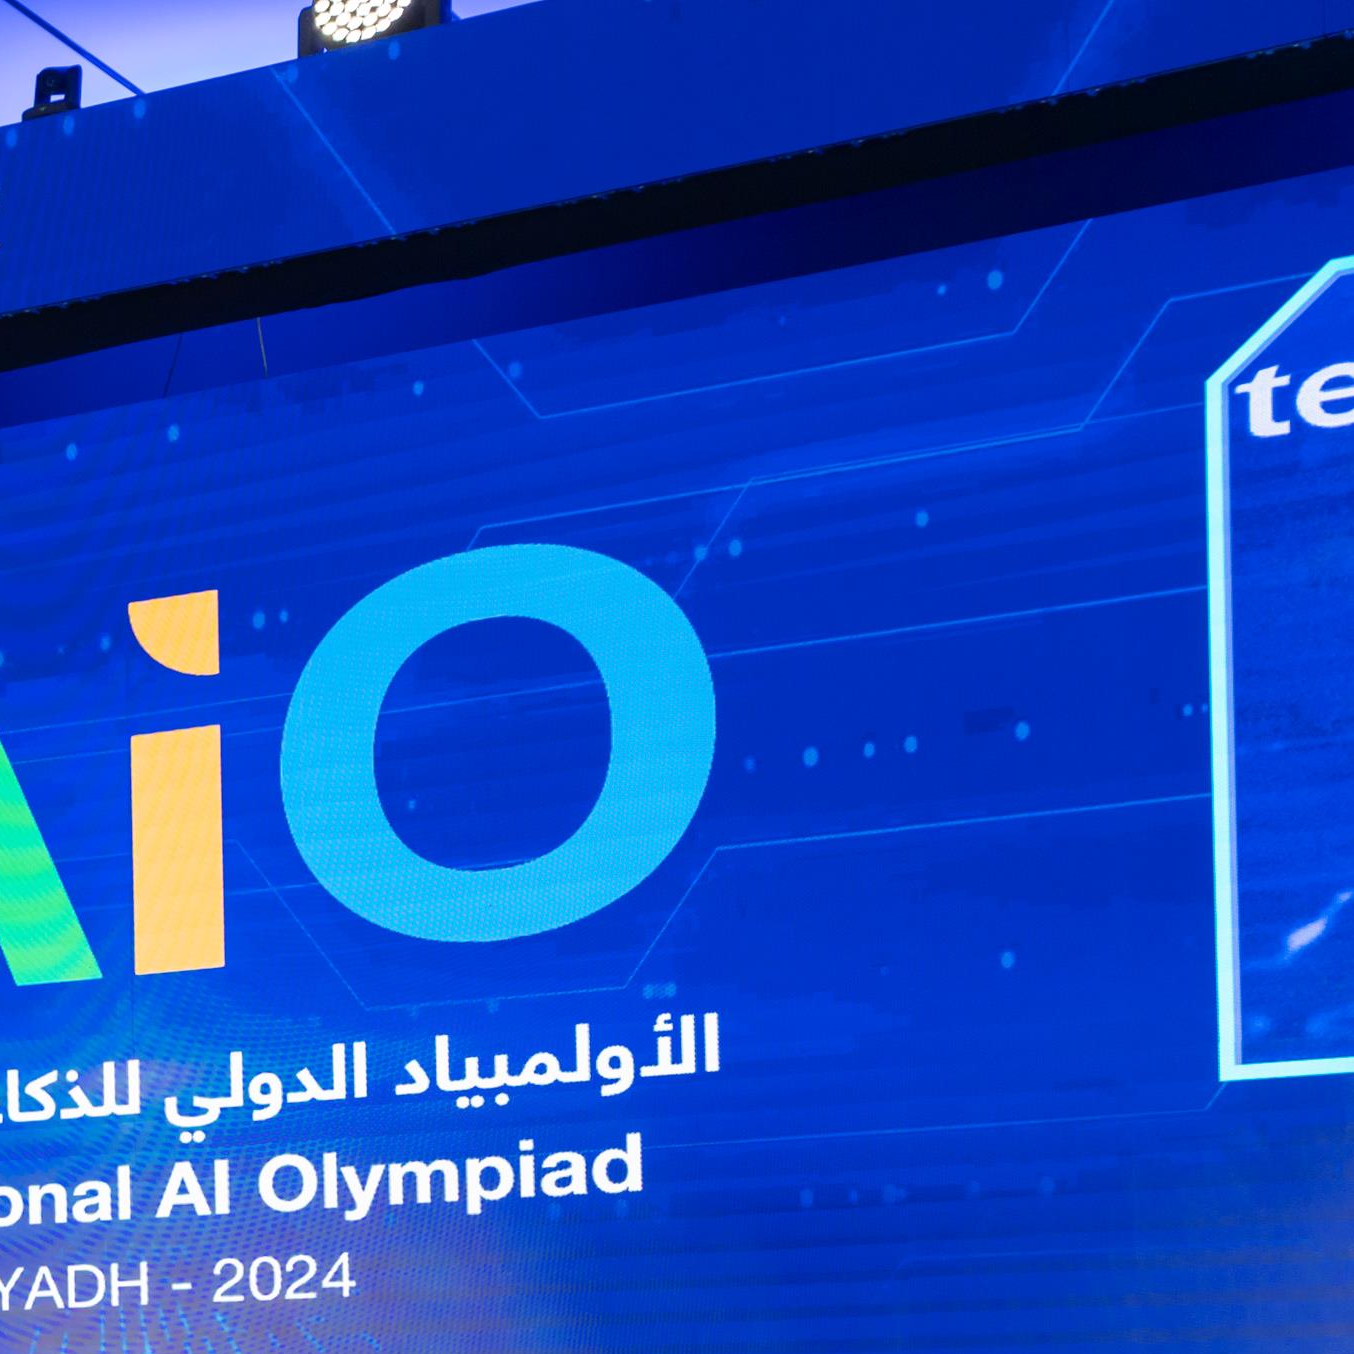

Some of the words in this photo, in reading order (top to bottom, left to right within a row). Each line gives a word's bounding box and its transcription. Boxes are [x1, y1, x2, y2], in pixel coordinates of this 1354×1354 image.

[164, 1041, 368, 1144] الدولي
[395, 1012, 720, 1109] الأولمبياد
[155, 1159, 231, 1218] AI
[258, 1132, 643, 1222] Olympiad
[212, 1251, 357, 1303] 2024
